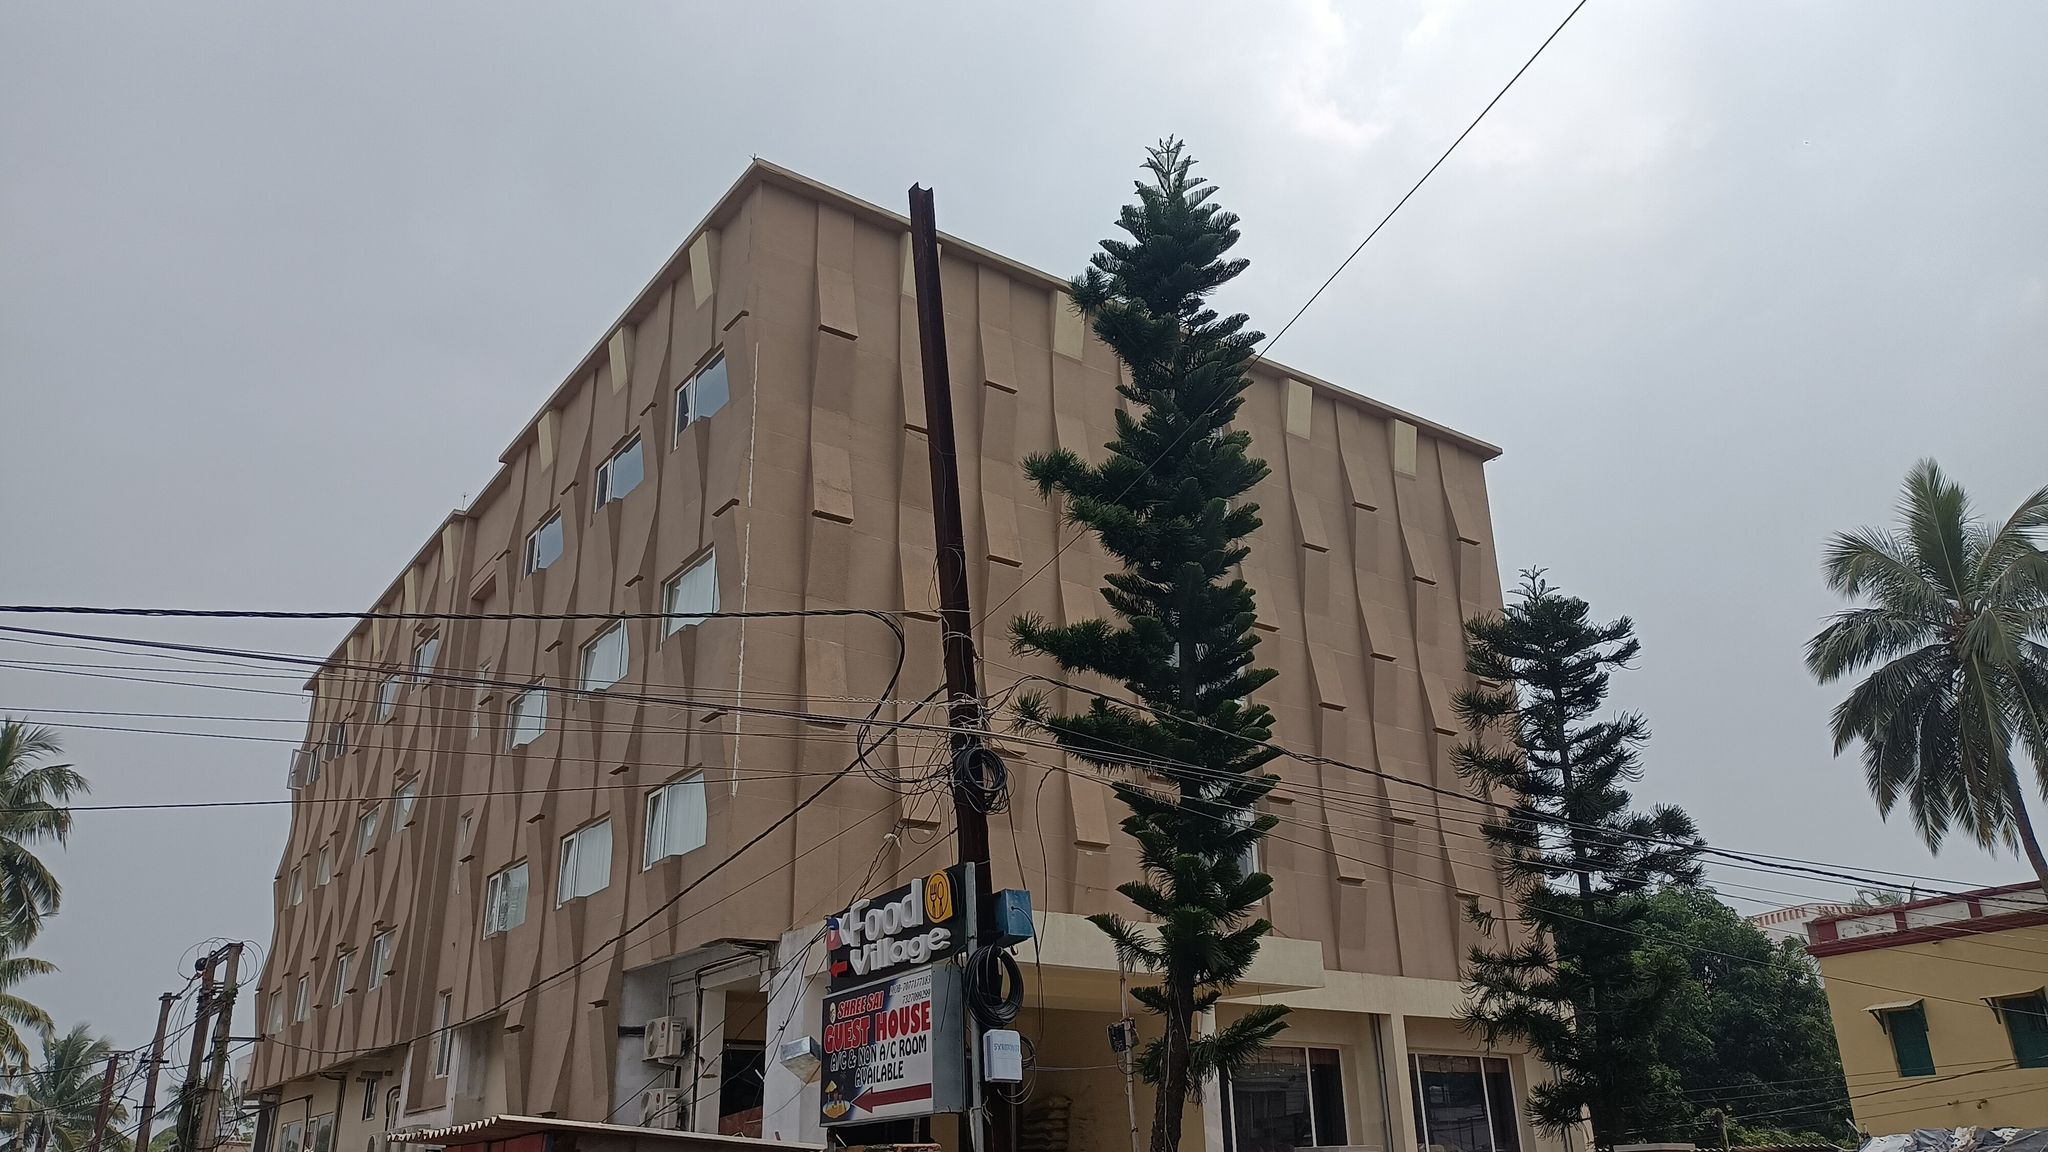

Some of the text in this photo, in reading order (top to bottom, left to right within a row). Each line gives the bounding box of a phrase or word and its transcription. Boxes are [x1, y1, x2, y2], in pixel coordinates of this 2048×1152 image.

[850, 898, 923, 947] Food
[850, 928, 951, 975] Village
[837, 991, 884, 1019] SHREE SAI
[824, 999, 931, 1054] GUEST HOUSE
[830, 1034, 927, 1072] A/C & NON A/C ROOM
[855, 1061, 904, 1087] AVAILABLE
